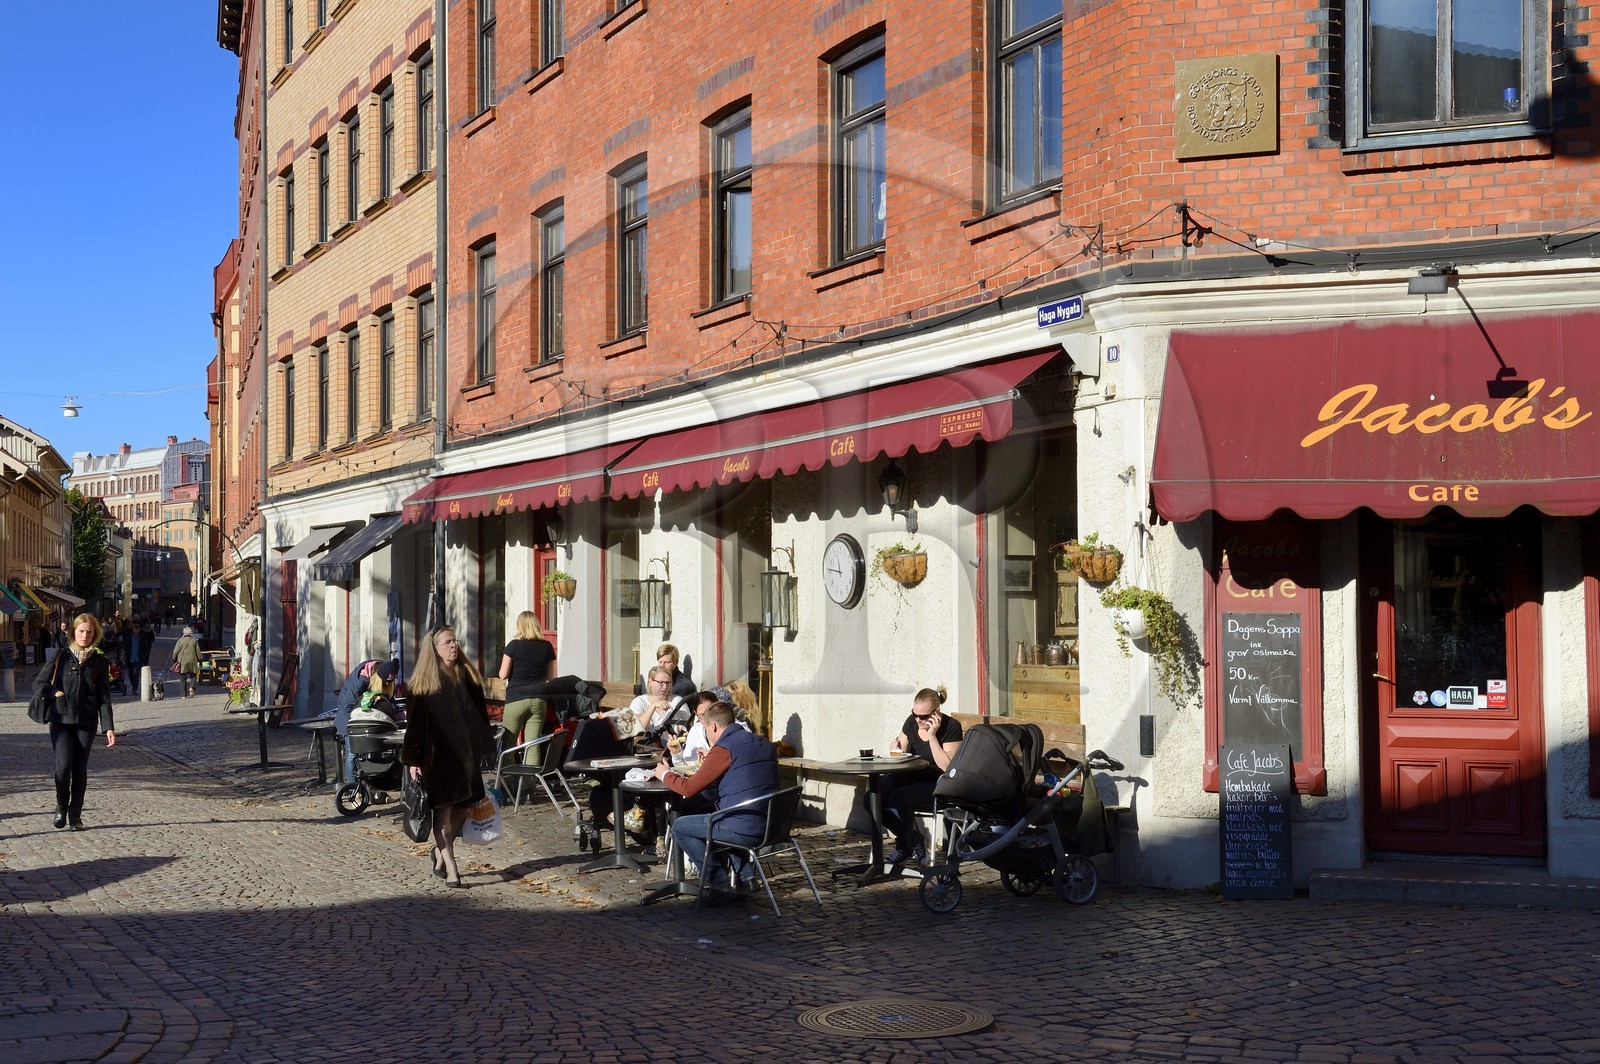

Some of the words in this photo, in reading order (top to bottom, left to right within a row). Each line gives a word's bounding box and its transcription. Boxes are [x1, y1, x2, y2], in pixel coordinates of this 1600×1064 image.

[1188, 67, 1238, 100] GÖTEBORGS
[1241, 72, 1264, 98] STADS
[1039, 310, 1056, 323] Haga
[1056, 302, 1080, 319] Nygata
[1109, 347, 1117, 360] 10
[942, 410, 981, 424] ESPRESSO
[1300, 378, 1592, 448] Jacob's
[722, 454, 751, 480] Jacob's
[1227, 619, 1266, 640] Dagens
[1266, 618, 1300, 639] Soppa
[1229, 667, 1246, 680] 50
[1451, 690, 1473, 700] HAGA
[1225, 779, 1273, 792] Hembakade
